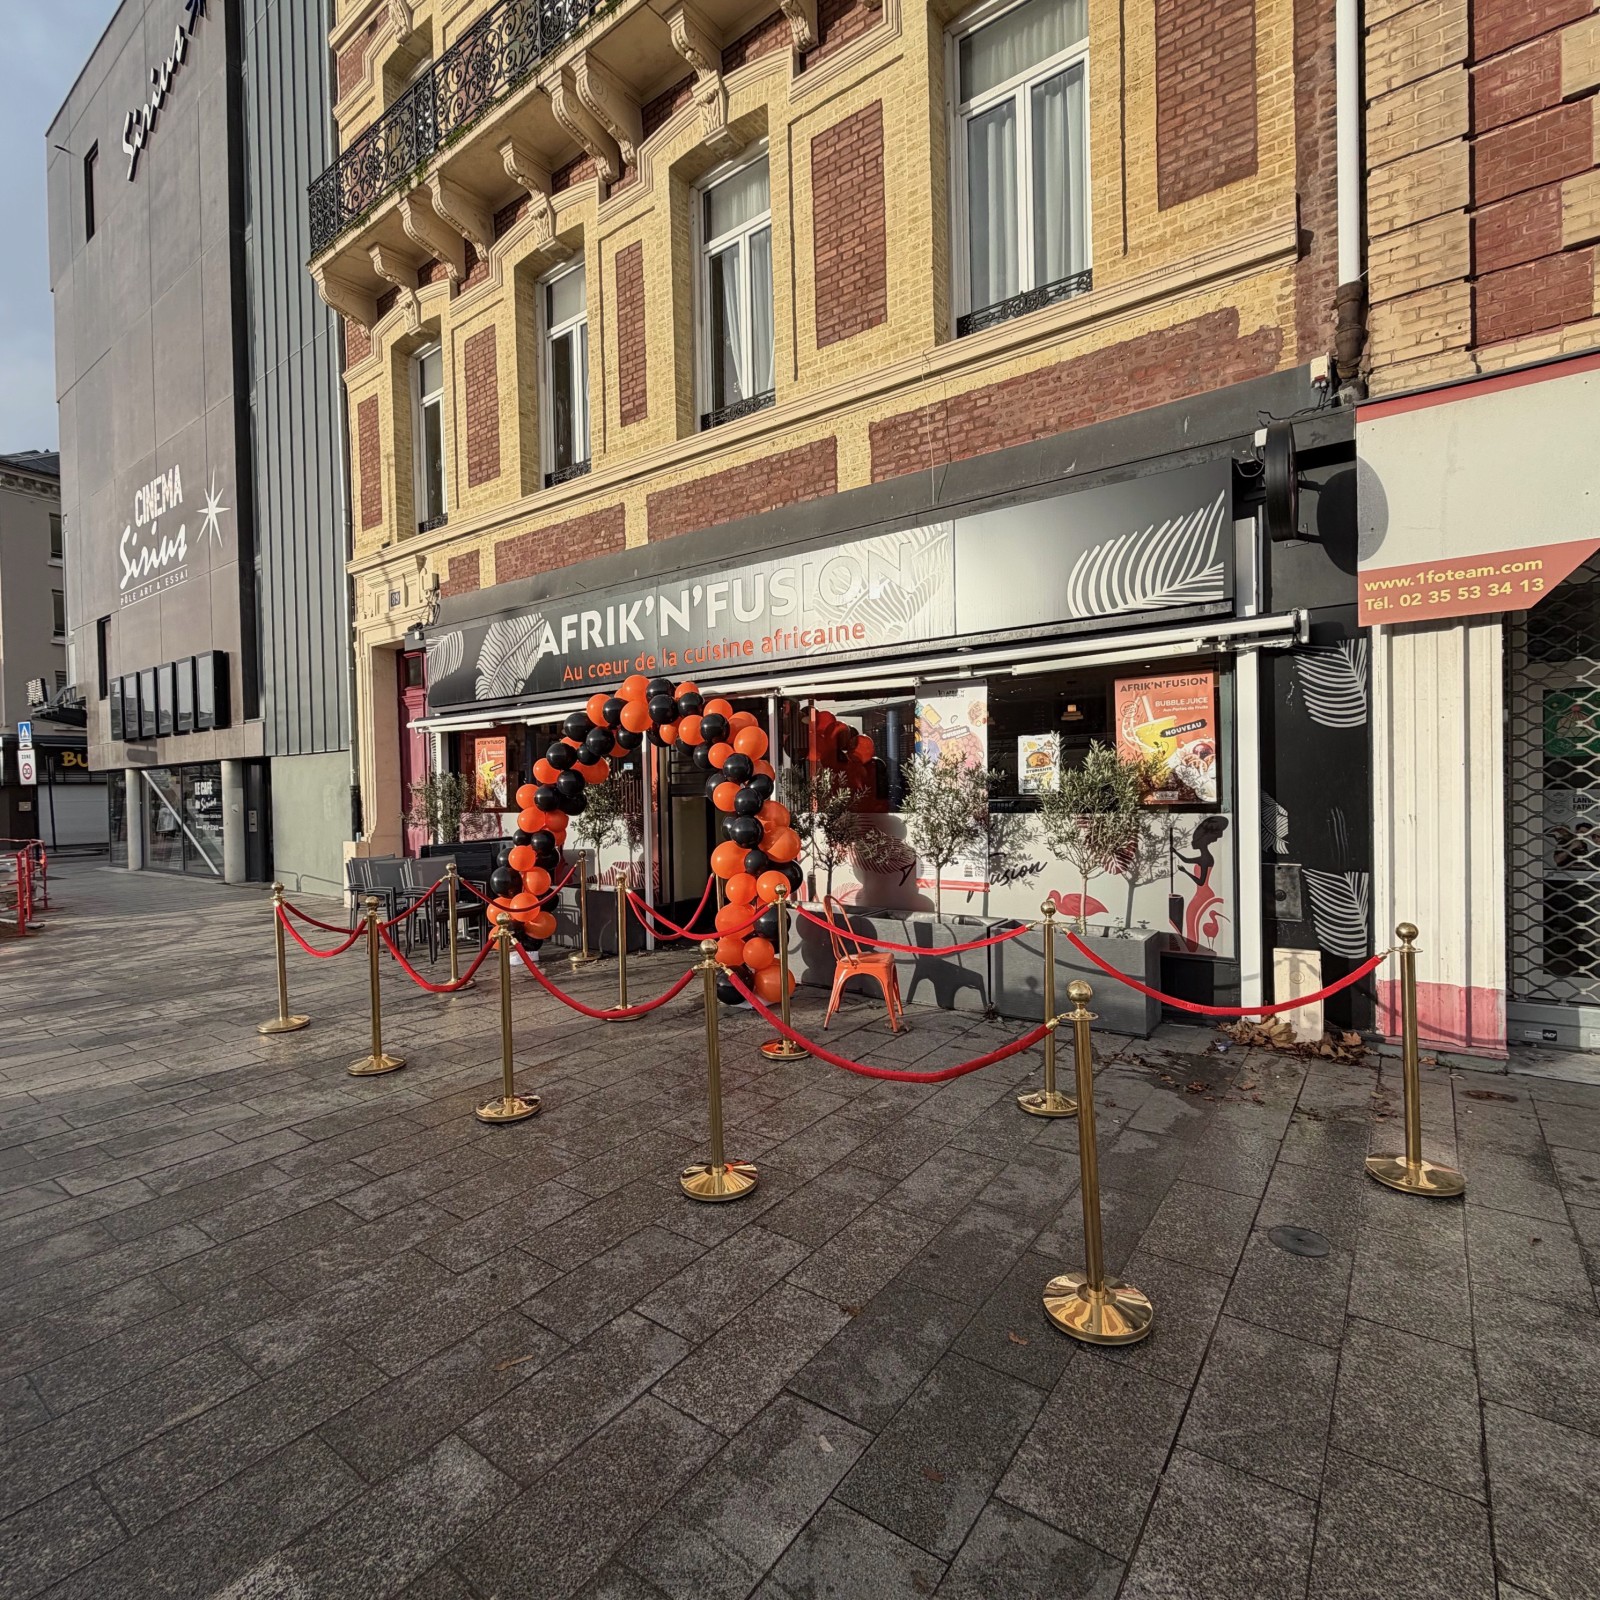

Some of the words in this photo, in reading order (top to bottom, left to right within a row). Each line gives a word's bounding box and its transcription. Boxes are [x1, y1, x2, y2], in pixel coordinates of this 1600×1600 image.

[135, 464, 183, 527] CINEMA
[120, 520, 187, 589] Sirius
[140, 585, 152, 597] ART
[165, 569, 188, 586] ESSAI
[1364, 559, 1543, 591] www.1foteam.com
[391, 592, 400, 604] 89
[538, 542, 913, 658] AFRIK'N'FUSION
[1364, 596, 1394, 611] Tél.
[1399, 592, 1422, 607] 02
[1428, 589, 1451, 604] 35
[1457, 585, 1481, 600] 53
[1487, 581, 1513, 597] 34
[1519, 577, 1544, 593] 13
[563, 665, 583, 681] Au
[588, 658, 630, 678] cœur
[635, 651, 656, 672] de
[662, 648, 677, 667] la
[684, 638, 754, 664] cuisine
[762, 621, 865, 653] africaine
[1120, 676, 1208, 692] AFRIK'N'FUSION
[1155, 698, 1185, 707] BUBBLE
[1186, 696, 1208, 705] JUICE
[1165, 722, 1202, 736] NOUVEAU
[23, 766, 31, 775] 30
[988, 852, 1047, 887] usion
